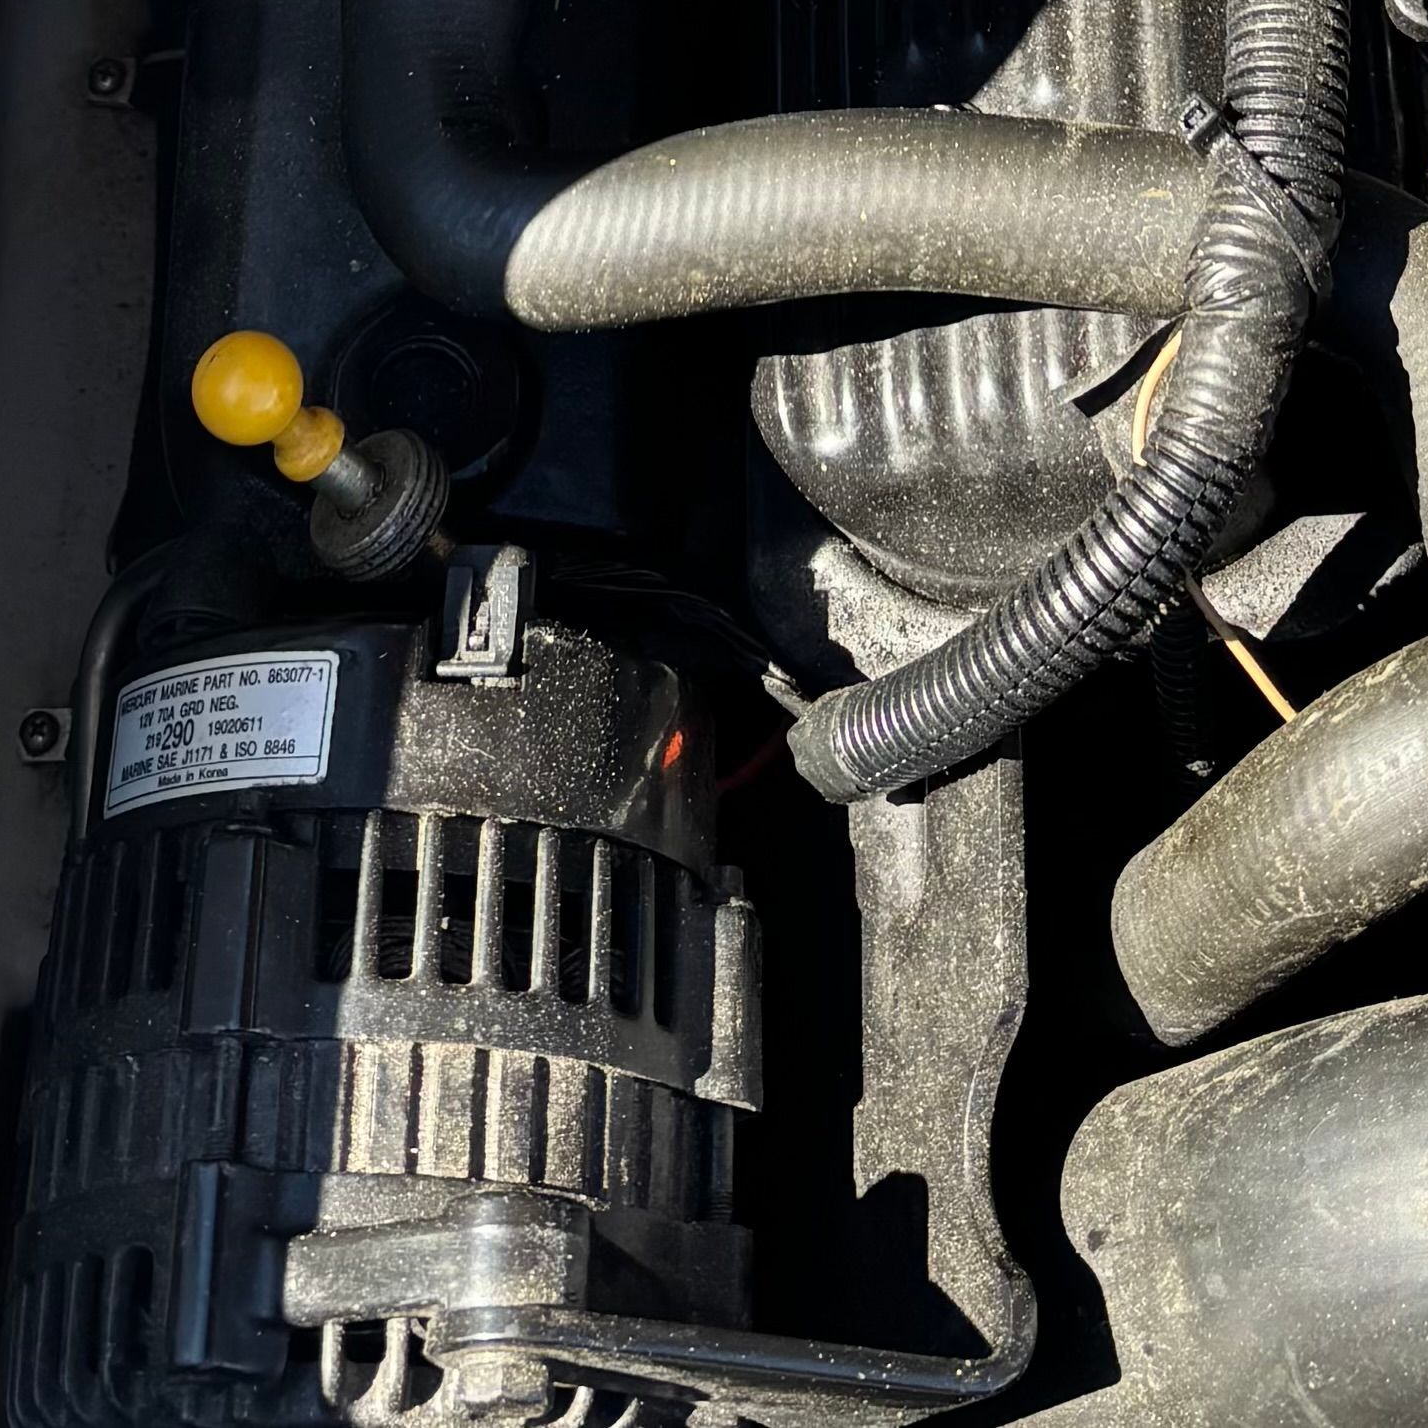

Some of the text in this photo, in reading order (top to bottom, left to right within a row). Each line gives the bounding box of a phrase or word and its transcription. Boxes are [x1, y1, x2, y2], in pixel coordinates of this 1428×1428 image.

[121, 667, 324, 716] MERCURY MARINE PART NO. 863077-1
[139, 695, 239, 729] 12V 70A GRD NEG.
[208, 715, 263, 737] 19020611
[121, 738, 296, 782] MARINE SAE J1171 & ISO 8846
[157, 767, 229, 787] Made in Korea
